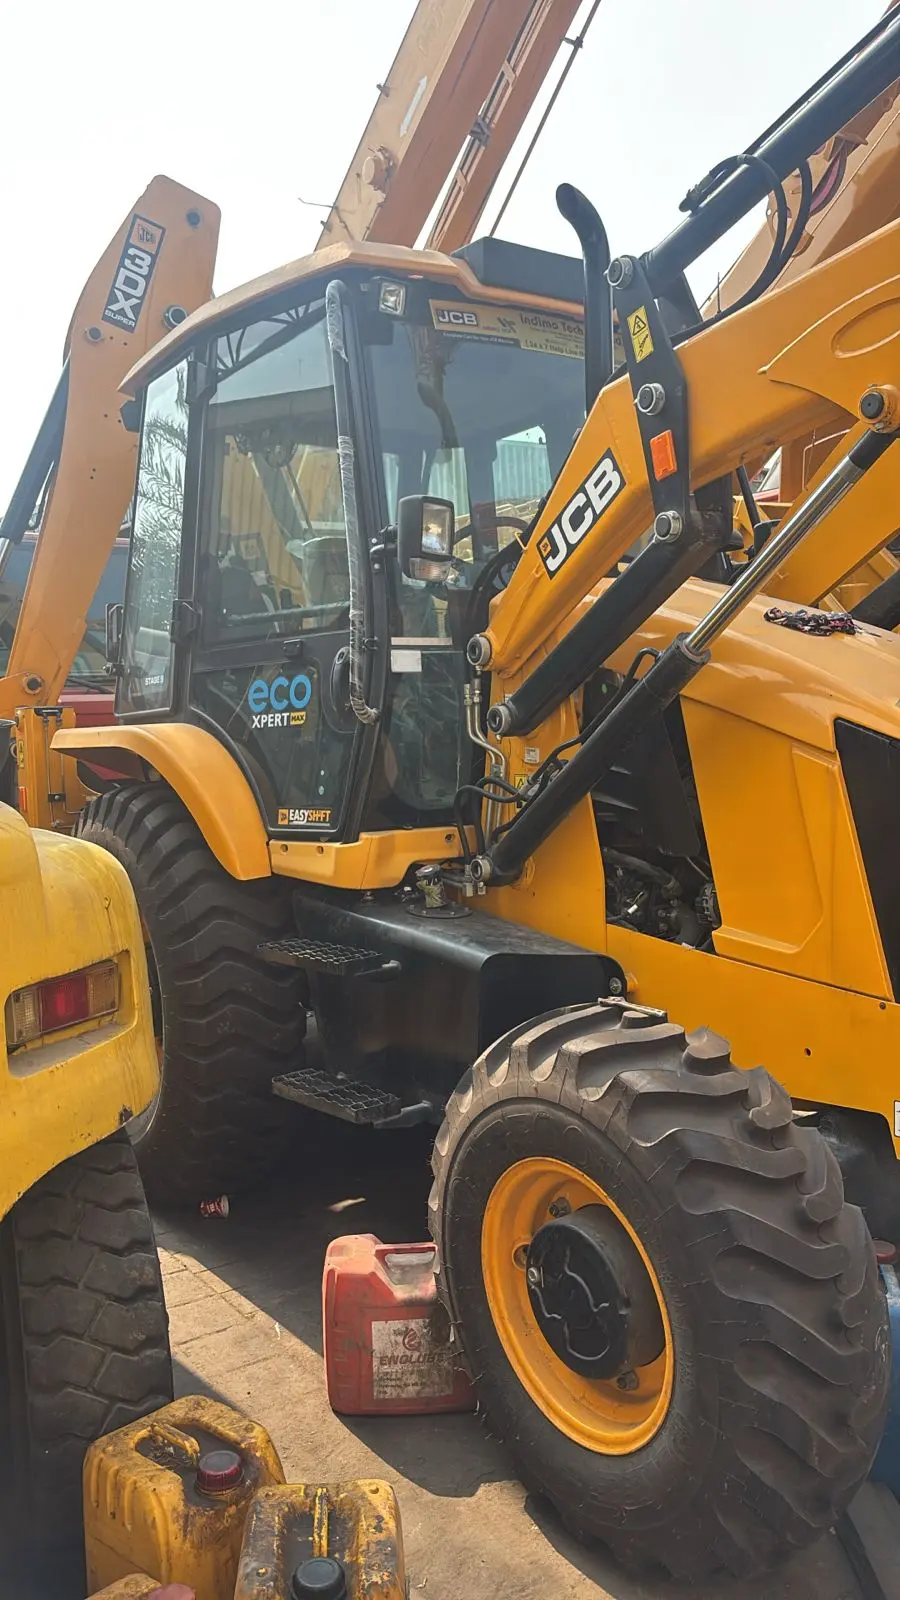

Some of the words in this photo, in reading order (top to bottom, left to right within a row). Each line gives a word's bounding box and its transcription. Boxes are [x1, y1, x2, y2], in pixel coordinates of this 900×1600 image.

[104, 309, 136, 328] SUPER
[438, 310, 477, 325] JCB
[546, 458, 621, 571] JCB
[248, 674, 312, 713] eco
[252, 713, 289, 729] XPERT
[291, 713, 305, 723] MAX
